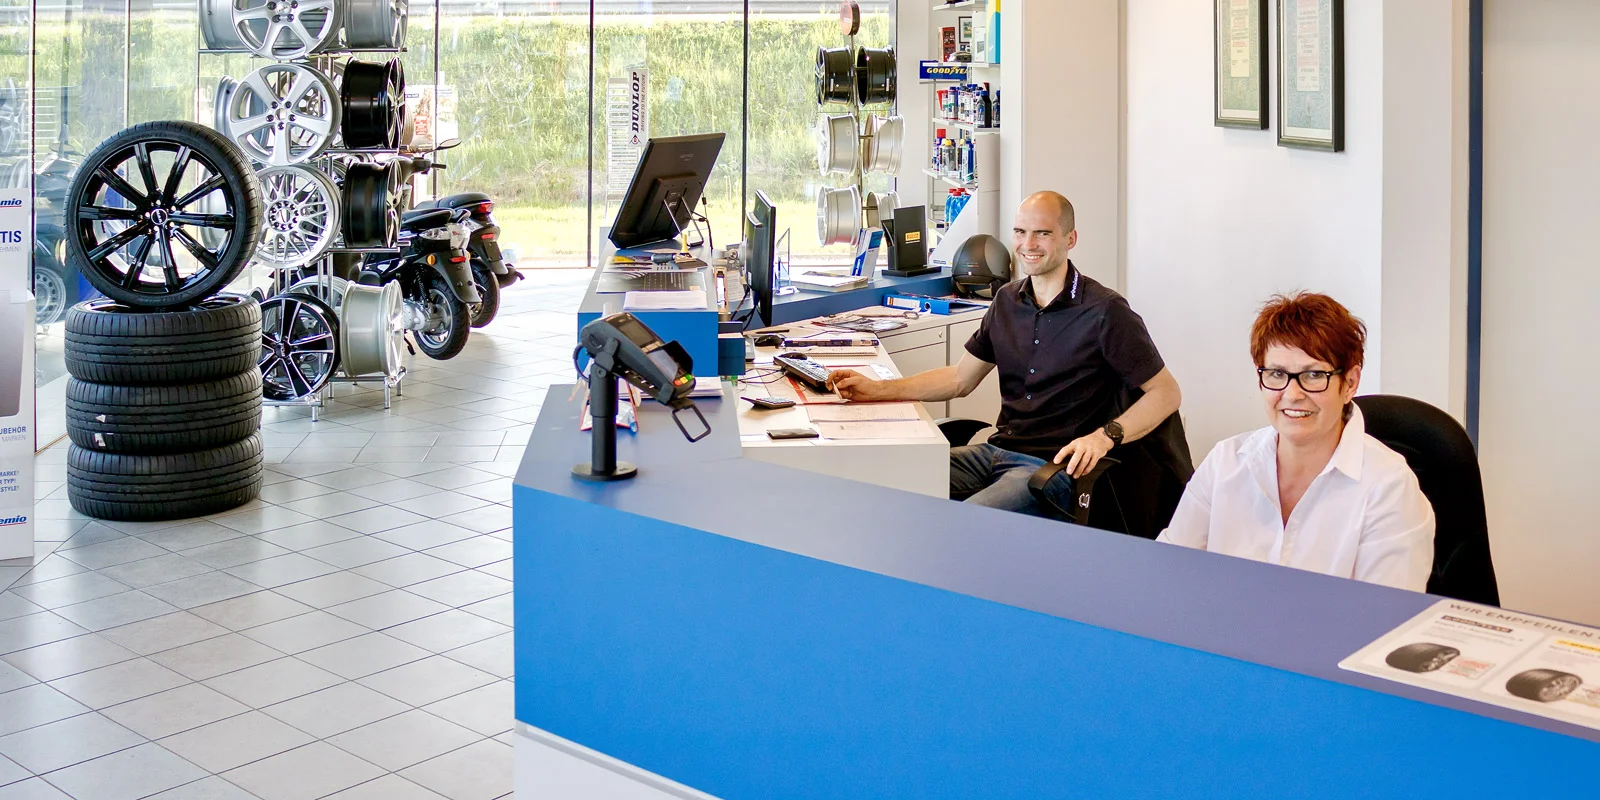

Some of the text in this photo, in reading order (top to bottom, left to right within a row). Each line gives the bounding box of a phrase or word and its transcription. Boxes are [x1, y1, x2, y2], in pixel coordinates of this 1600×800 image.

[0, 198, 22, 206] mio
[0, 230, 22, 243] TIS
[0, 515, 27, 525] emio
[1450, 603, 1482, 615] WIR
[1485, 611, 1594, 638] EMPFEHLEN
